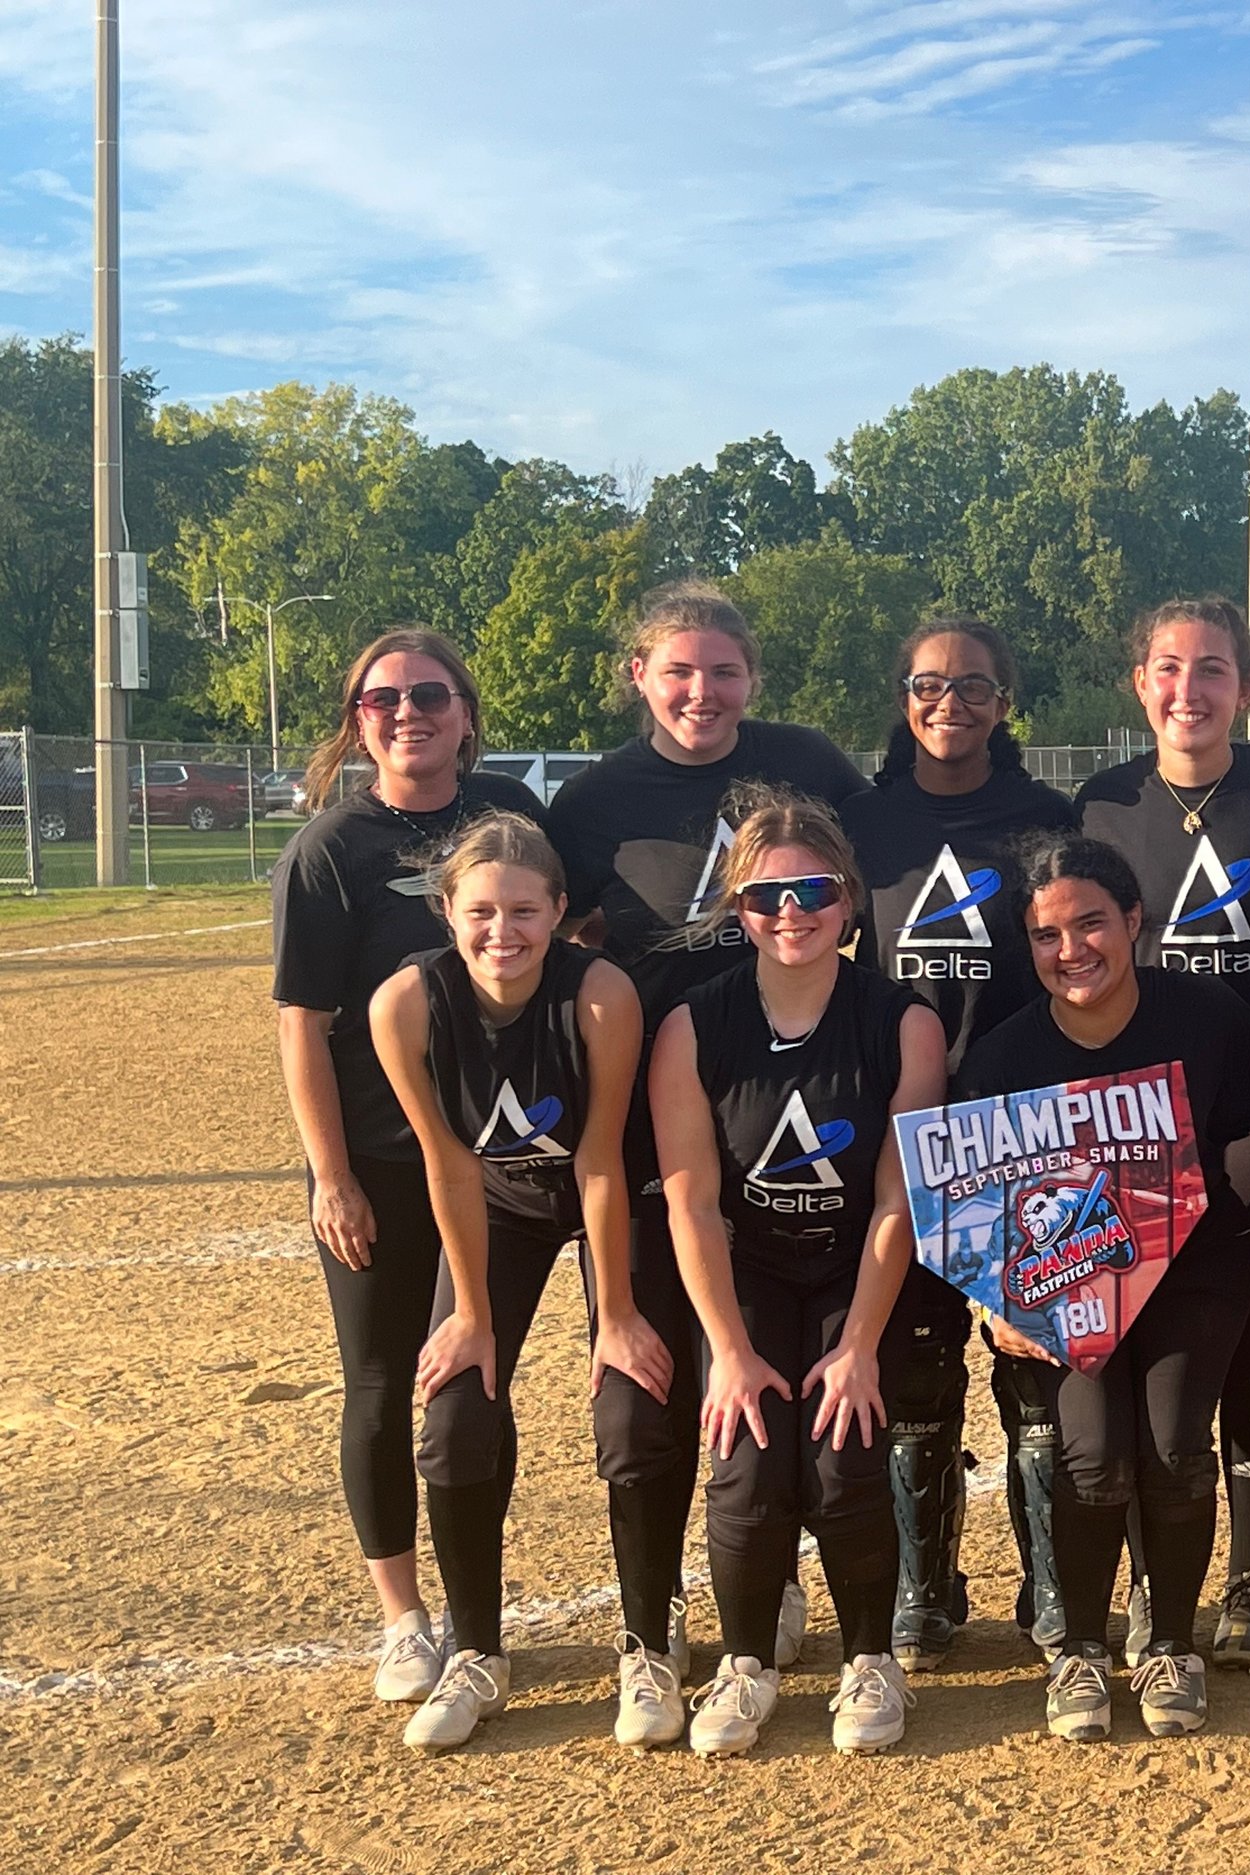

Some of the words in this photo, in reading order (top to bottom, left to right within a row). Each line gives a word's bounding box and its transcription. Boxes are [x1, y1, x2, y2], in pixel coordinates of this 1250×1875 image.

[685, 923, 749, 952] Del
[896, 953, 992, 979] Delta
[917, 1078, 1178, 1189] CHAMPION
[949, 1152, 1073, 1200] SEPTEMBER
[1089, 1144, 1159, 1165] SMASH
[743, 1183, 844, 1213] Delta
[1017, 1214, 1130, 1289] PANDA
[1023, 1259, 1094, 1304] FASTPITCH
